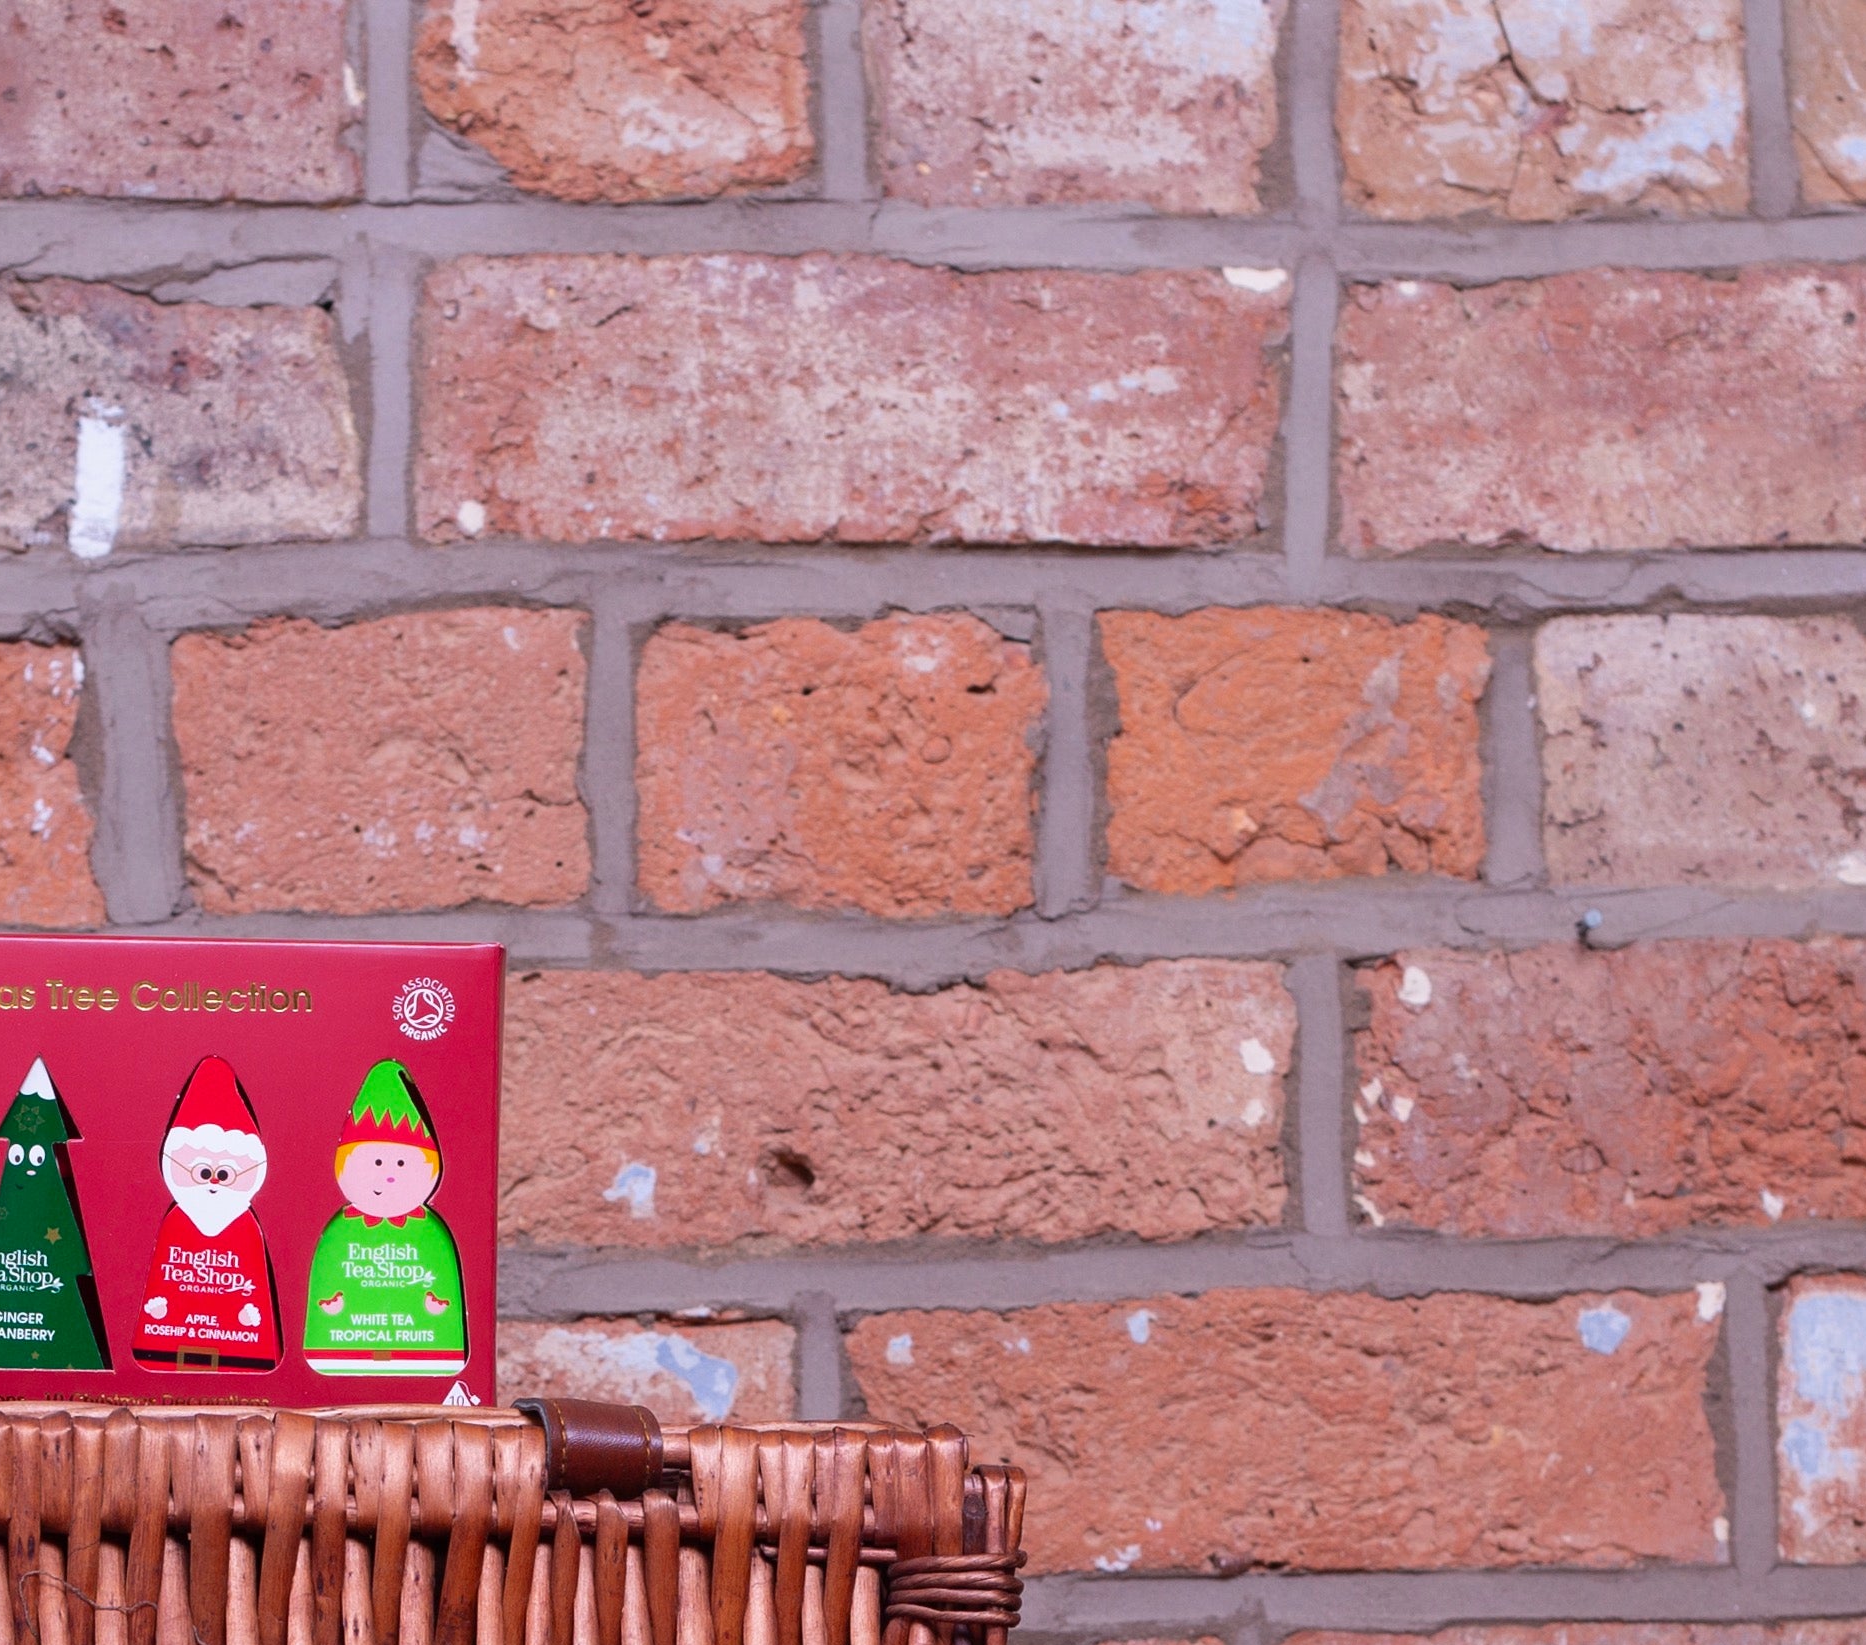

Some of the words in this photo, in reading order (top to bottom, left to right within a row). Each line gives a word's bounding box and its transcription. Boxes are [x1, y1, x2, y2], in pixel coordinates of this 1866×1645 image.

[46, 979, 120, 1012] Tree
[130, 980, 314, 1013] Collection
[391, 995, 406, 1021] SOIL
[401, 977, 456, 1023] ASSOCIATION
[330, 1330, 393, 1342] TROPICAL
[395, 1330, 435, 1342] FRUITS
